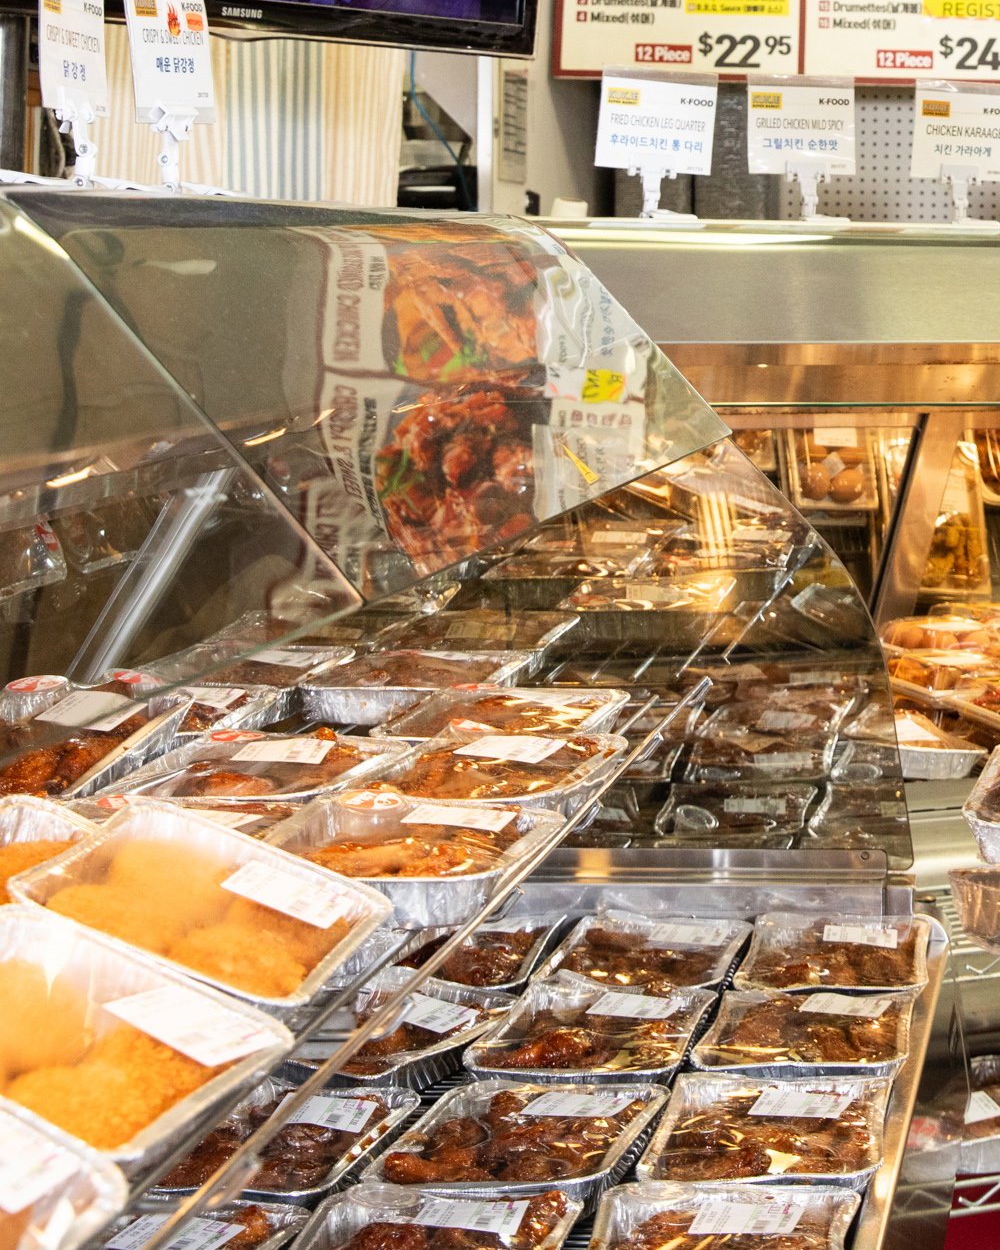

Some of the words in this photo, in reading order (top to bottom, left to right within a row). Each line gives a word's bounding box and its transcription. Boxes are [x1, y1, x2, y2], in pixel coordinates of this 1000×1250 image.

[83, 2, 103, 17] K-FOOD
[181, 2, 203, 13] K-FOOD
[221, 6, 263, 19] SAMSUNG
[47, 24, 60, 42] CRISPY
[65, 30, 80, 48] SWEET
[81, 33, 101, 54] CHICKEN
[142, 28, 159, 43] CRISPY
[183, 30, 204, 46] CHICKEN
[636, 46, 652, 61] 12
[655, 47, 691, 62] Piece
[877, 52, 894, 68] 12
[896, 53, 932, 69] Piece
[156, 56, 171, 73] 매운
[173, 57, 195, 74] 닭강정
[608, 90, 639, 100] KUKJE
[680, 98, 714, 107] K-FOOD
[819, 98, 850, 106] K-FOOD
[924, 103, 949, 112] KUKJE
[611, 113, 629, 125] FRIED
[631, 115, 659, 128] CHICKEN
[661, 117, 673, 129] LEG
[675, 119, 705, 132] QUARTER
[756, 117, 781, 128] GRILLED
[783, 118, 810, 129] CHICKEN
[811, 119, 827, 130] MILD
[828, 119, 844, 130] SPICY
[926, 124, 963, 137] CHICKEN
[610, 133, 668, 150] 후라이드치킨
[684, 140, 703, 153] 다리
[763, 138, 804, 150] 그릴치킨
[808, 139, 838, 151] 순한맛
[934, 144, 953, 155] 치킨
[955, 145, 992, 157] 가라아게
